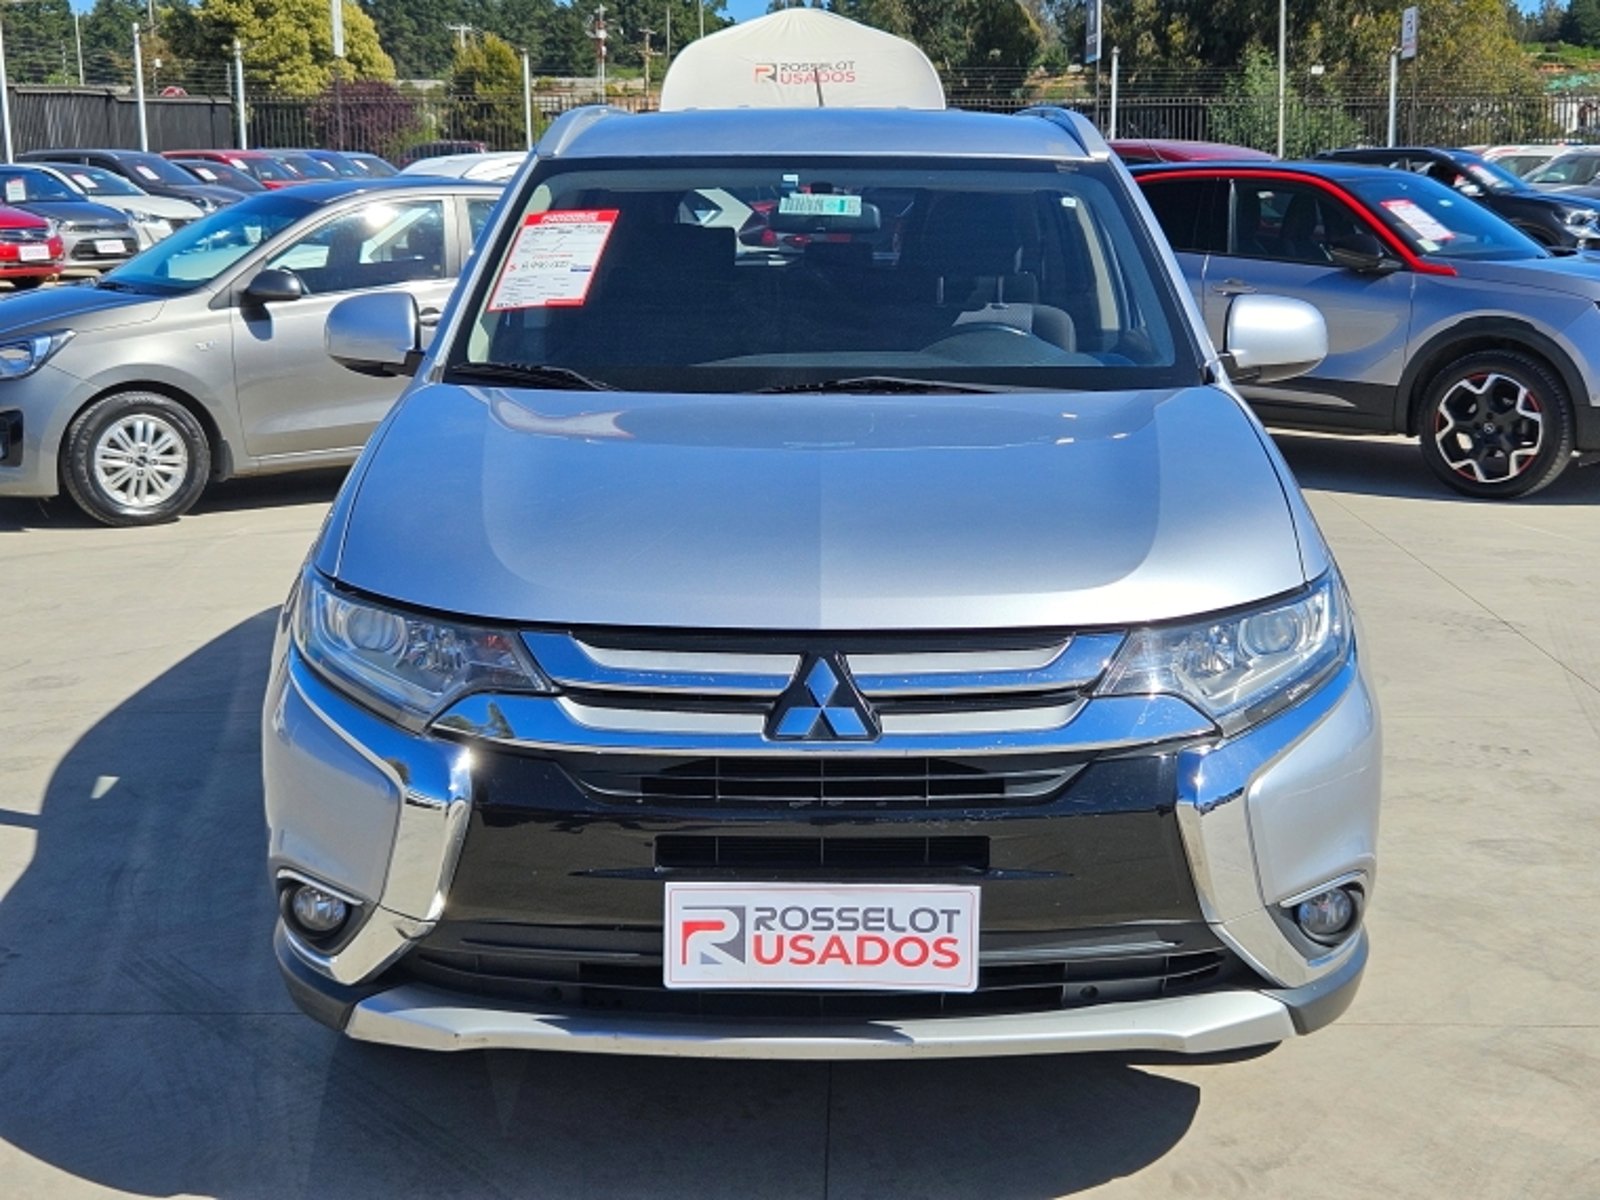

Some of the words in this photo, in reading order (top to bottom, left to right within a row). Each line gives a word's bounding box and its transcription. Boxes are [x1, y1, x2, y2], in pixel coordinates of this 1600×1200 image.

[780, 61, 855, 72] ROSSELOT
[780, 72, 856, 85] USADOS
[754, 906, 960, 933] ROSSELOT
[753, 935, 960, 969] USADOS
